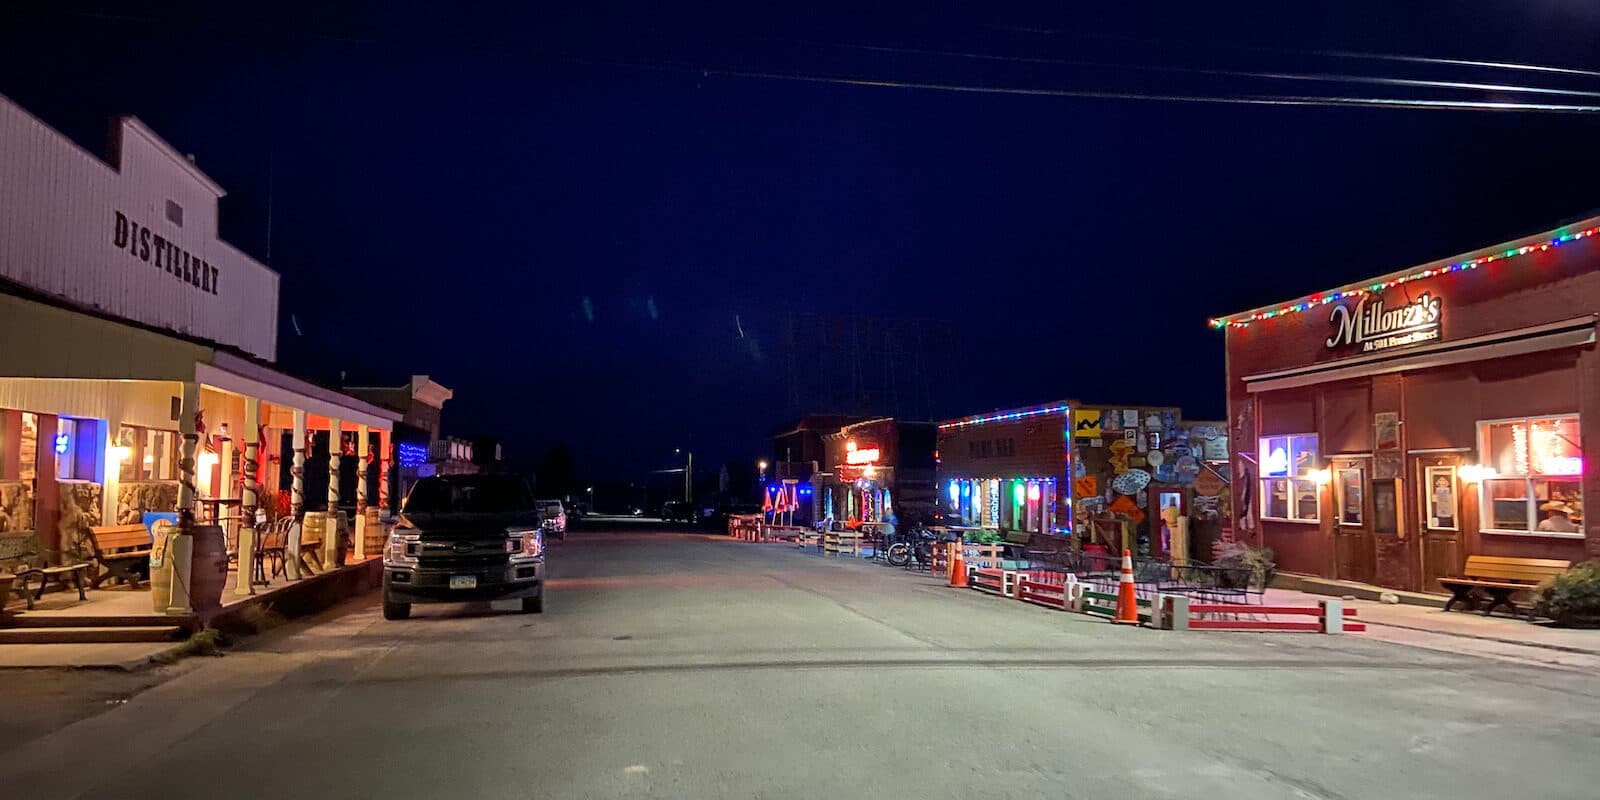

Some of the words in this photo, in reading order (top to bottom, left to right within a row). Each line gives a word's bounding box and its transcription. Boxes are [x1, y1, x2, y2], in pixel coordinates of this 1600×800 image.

[114, 210, 219, 296] DISTILLERY
[1326, 291, 1439, 348] Millonzi's
[1363, 342, 1373, 351] At
